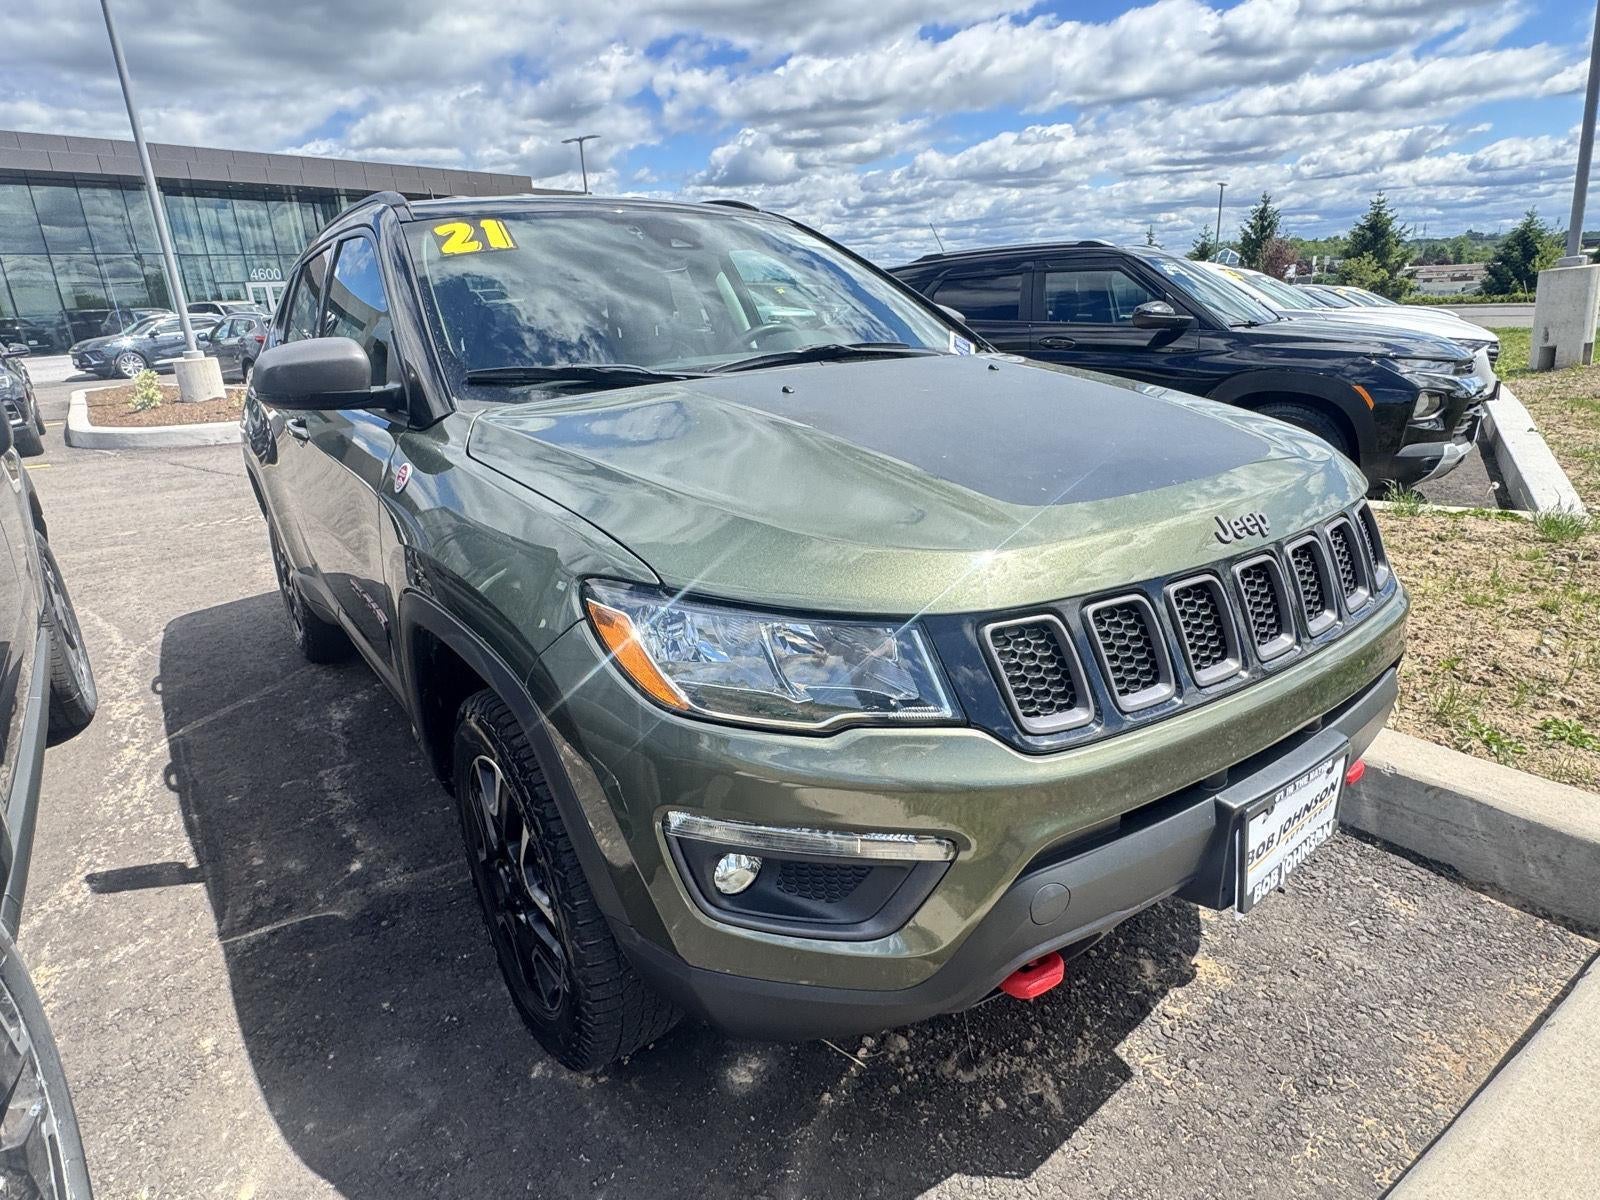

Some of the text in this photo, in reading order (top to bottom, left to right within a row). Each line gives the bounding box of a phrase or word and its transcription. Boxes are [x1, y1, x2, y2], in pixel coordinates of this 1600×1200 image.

[433, 219, 514, 256] 21
[250, 268, 281, 280] 4600
[1214, 512, 1271, 544] Jeep
[1247, 777, 1339, 865] BOB JOHNSON
[1285, 823, 1305, 845] AUTO
[1253, 820, 1333, 904] BOB JOHNSON
